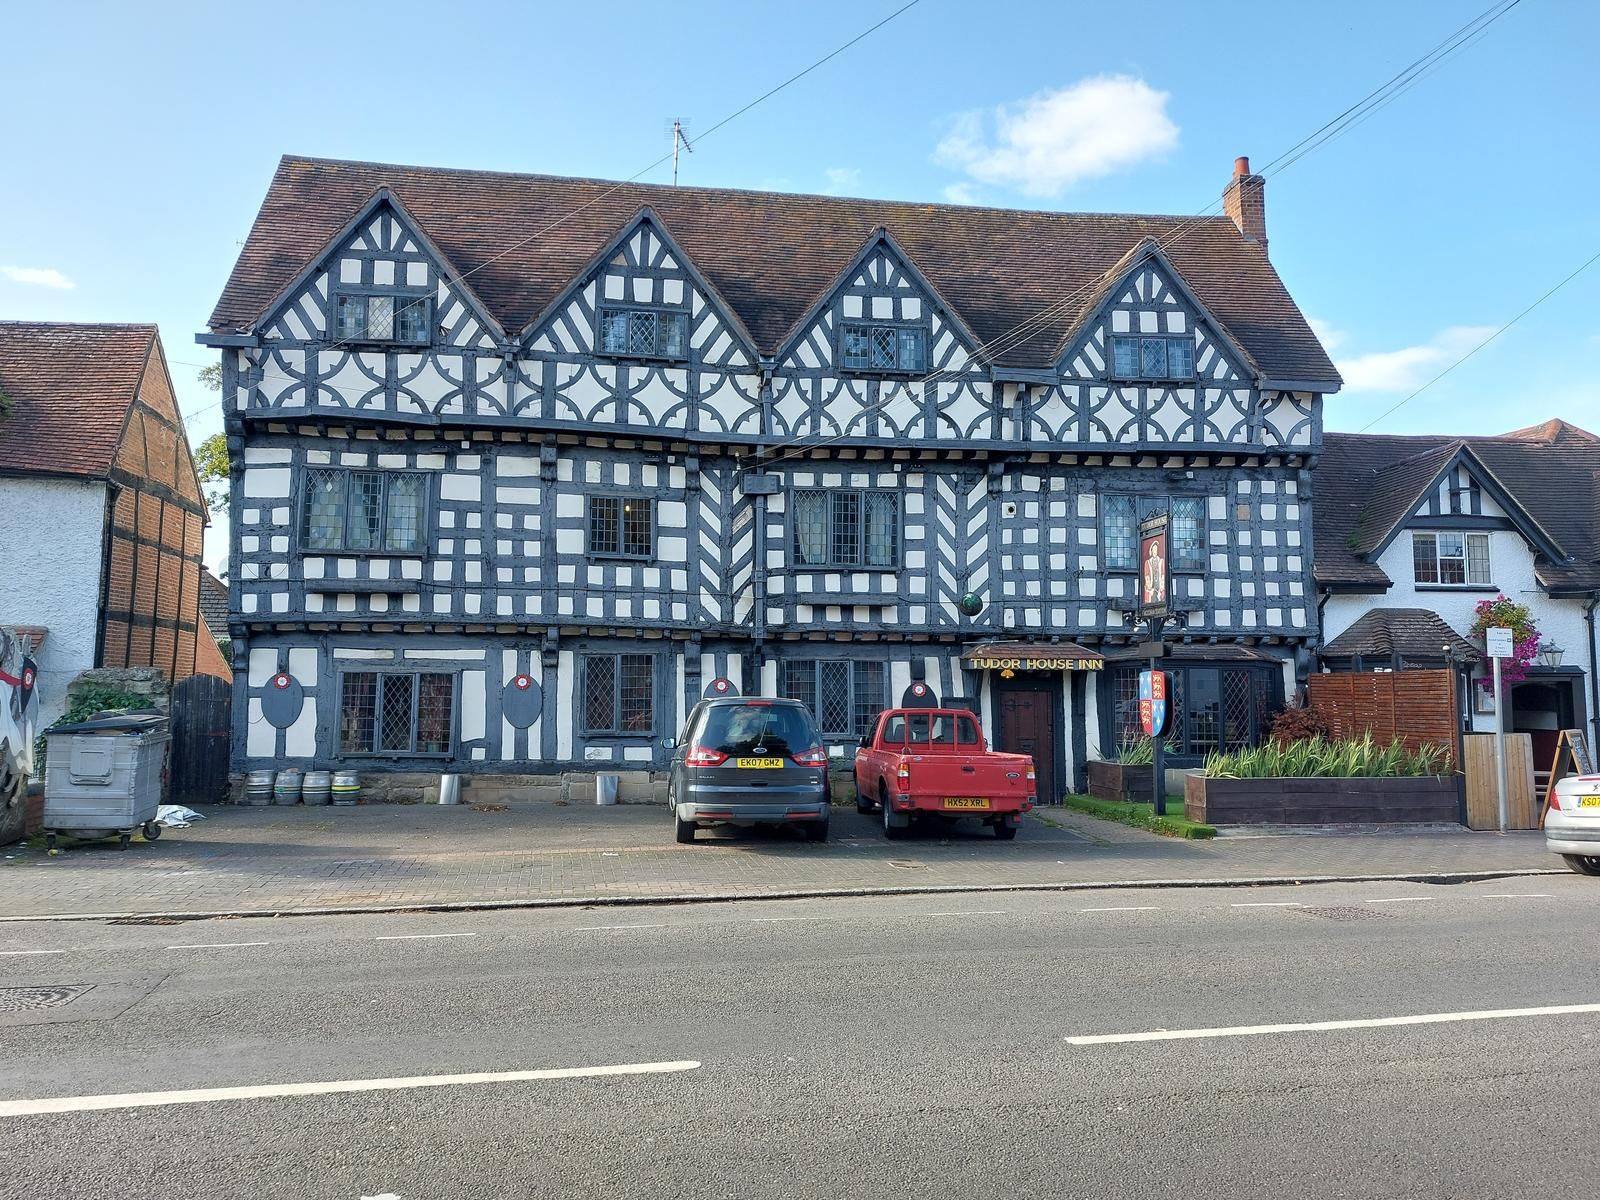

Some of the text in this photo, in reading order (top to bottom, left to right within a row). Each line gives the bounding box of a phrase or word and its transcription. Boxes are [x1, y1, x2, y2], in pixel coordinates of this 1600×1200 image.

[971, 659, 1102, 669] TUDOR HOUSE INN
[741, 758, 762, 767] EK07
[947, 799, 985, 807] HX52 XRL
